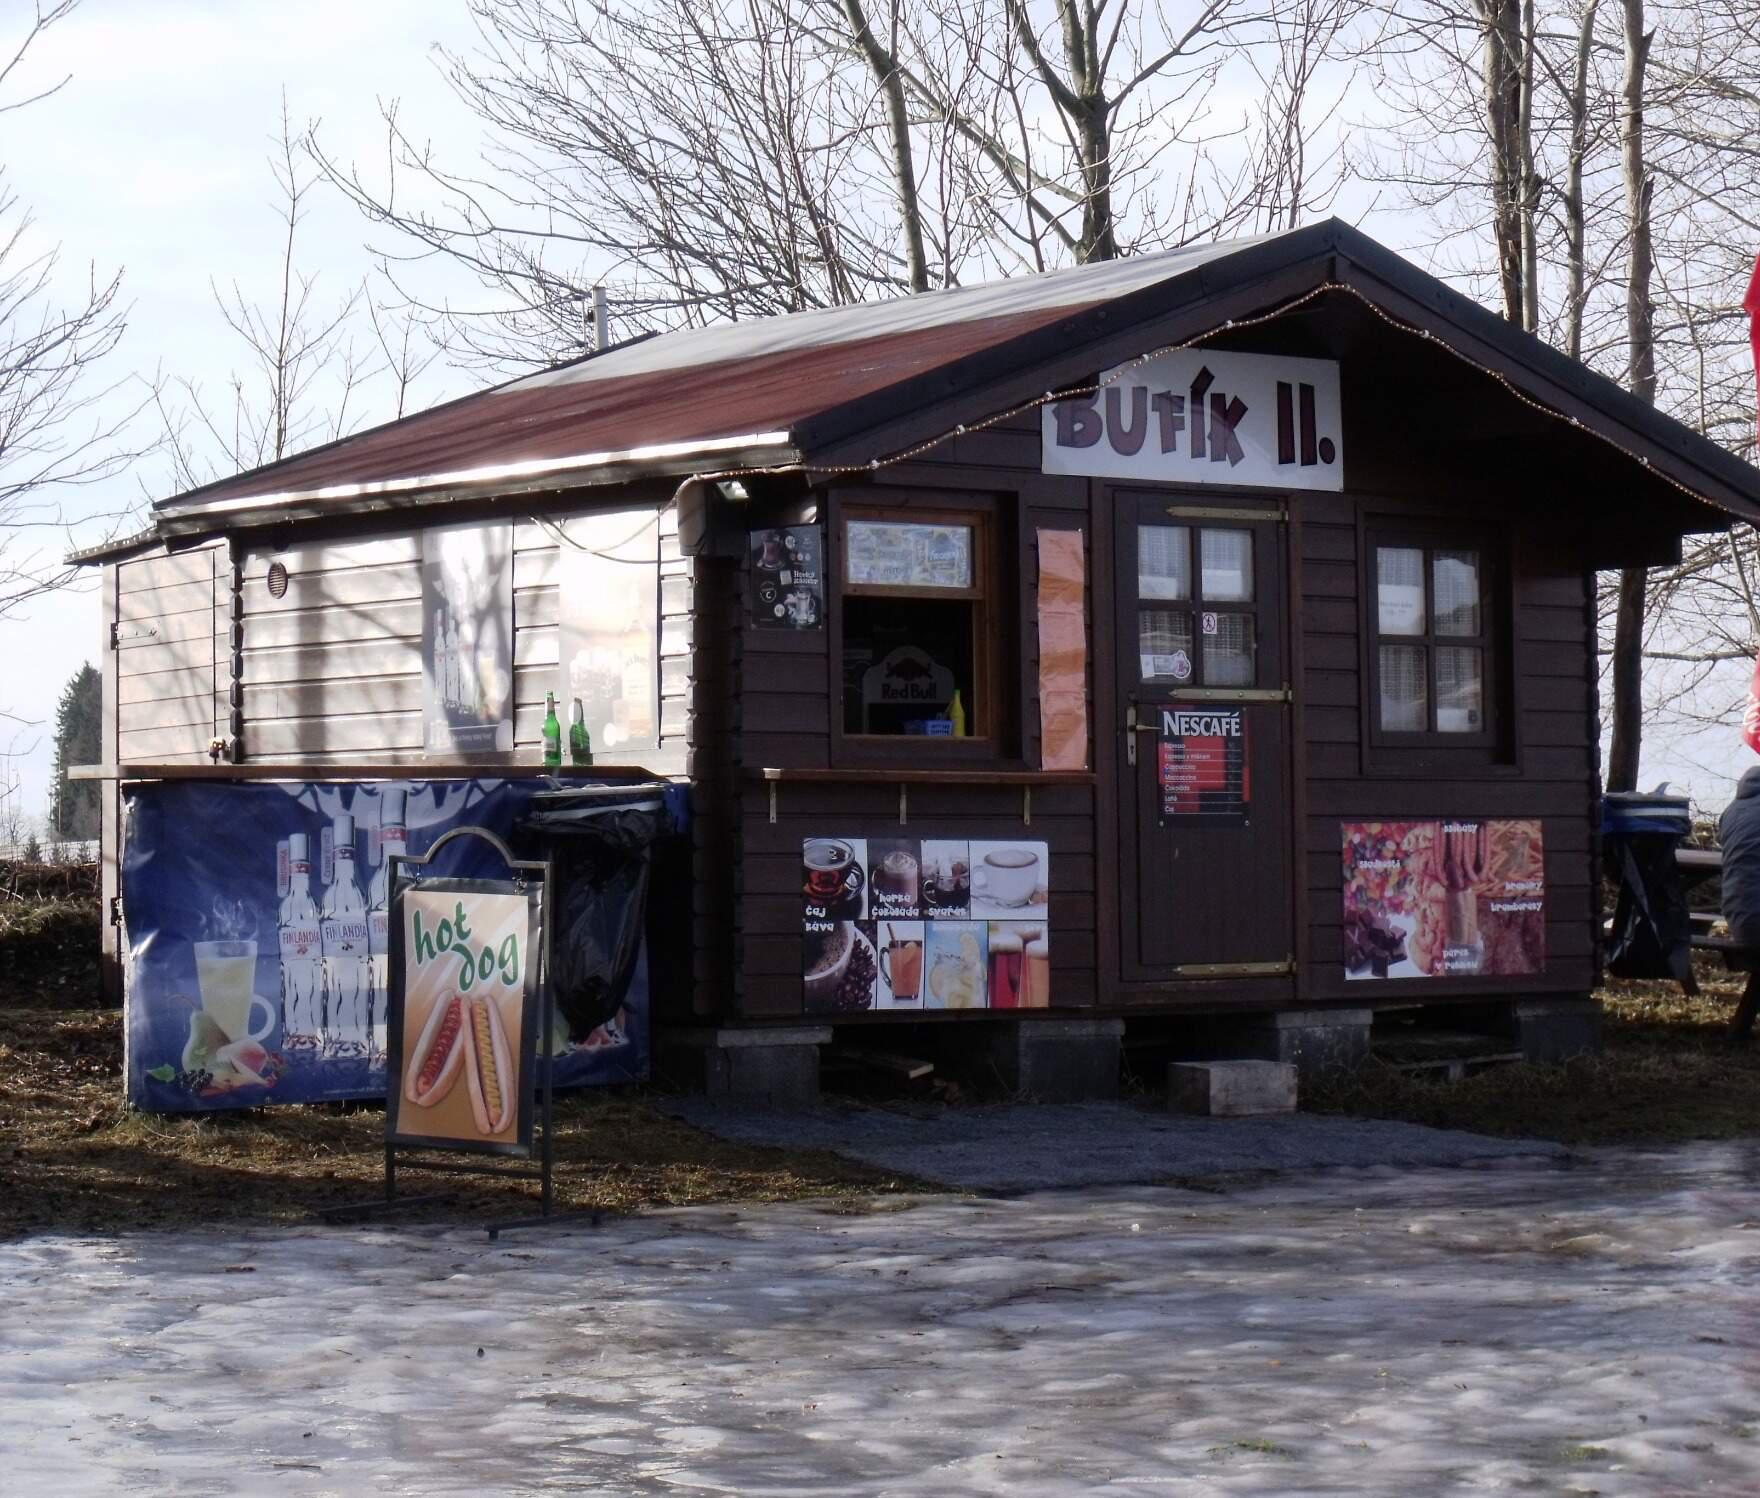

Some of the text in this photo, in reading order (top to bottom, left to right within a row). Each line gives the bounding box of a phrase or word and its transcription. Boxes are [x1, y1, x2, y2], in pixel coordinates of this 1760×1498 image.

[882, 682, 937, 700] Red Bull
[1163, 711, 1241, 737] NESCAFÉ
[805, 905, 826, 918] čaj
[282, 930, 320, 945] FINLANDIA
[325, 923, 367, 940] FINLANDIA
[413, 901, 471, 965] hot
[450, 933, 519, 991] dog
